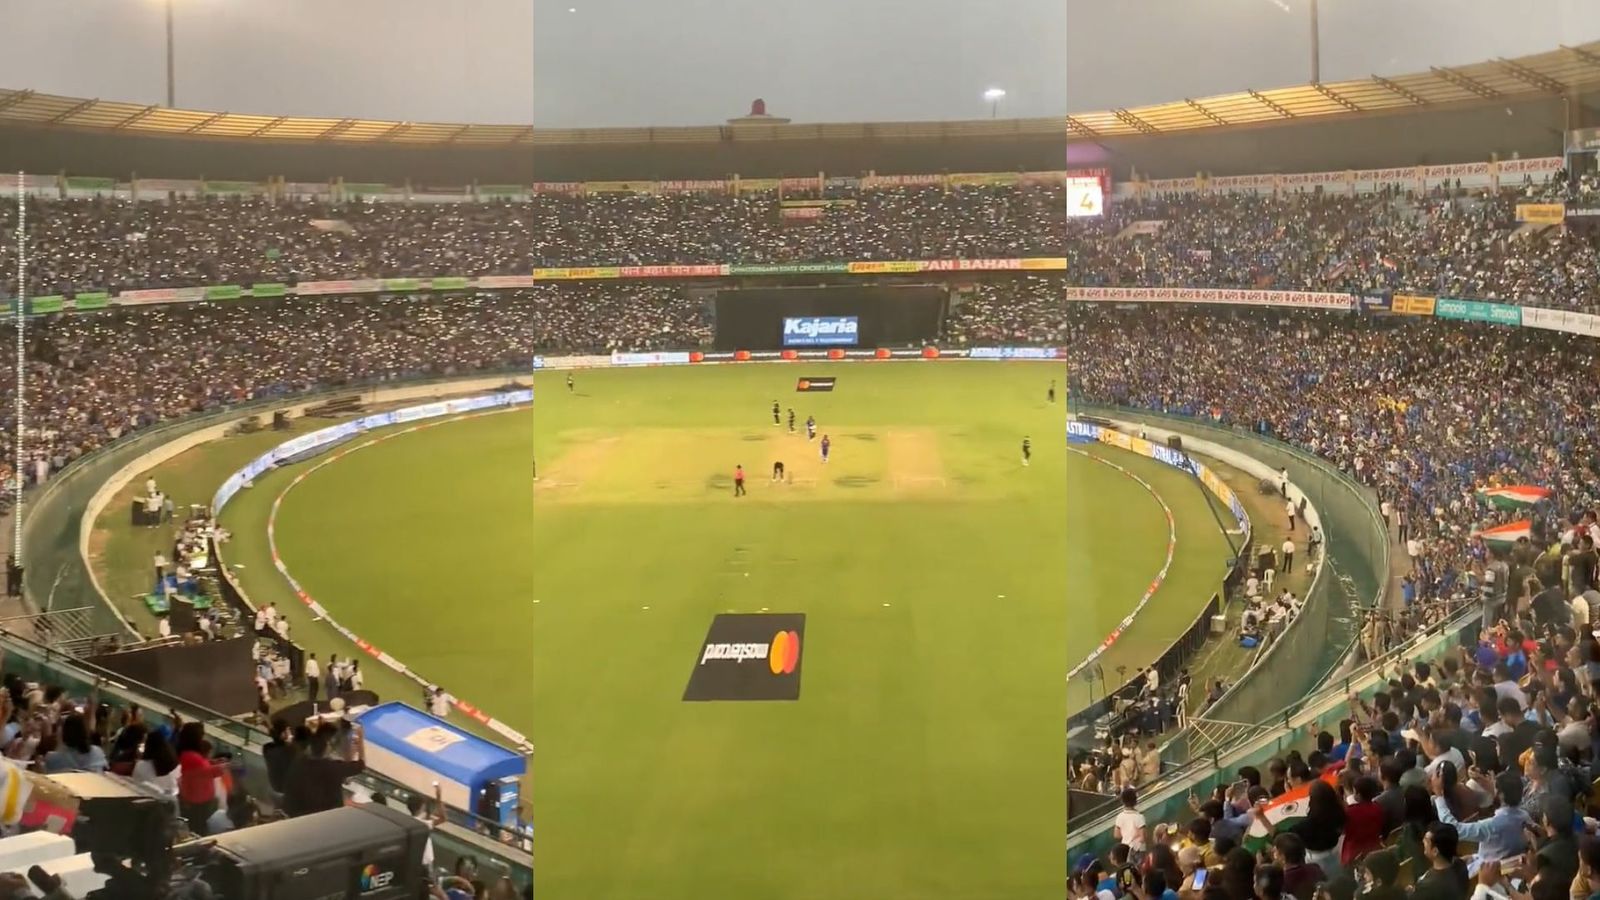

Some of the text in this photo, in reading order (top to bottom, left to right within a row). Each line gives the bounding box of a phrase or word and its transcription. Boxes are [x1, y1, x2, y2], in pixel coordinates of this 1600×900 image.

[1080, 193, 1094, 211] 4
[920, 260, 954, 270] PAN
[959, 258, 1021, 270] BAHAR
[784, 318, 858, 337] Kajaria
[369, 871, 395, 889] NEP
